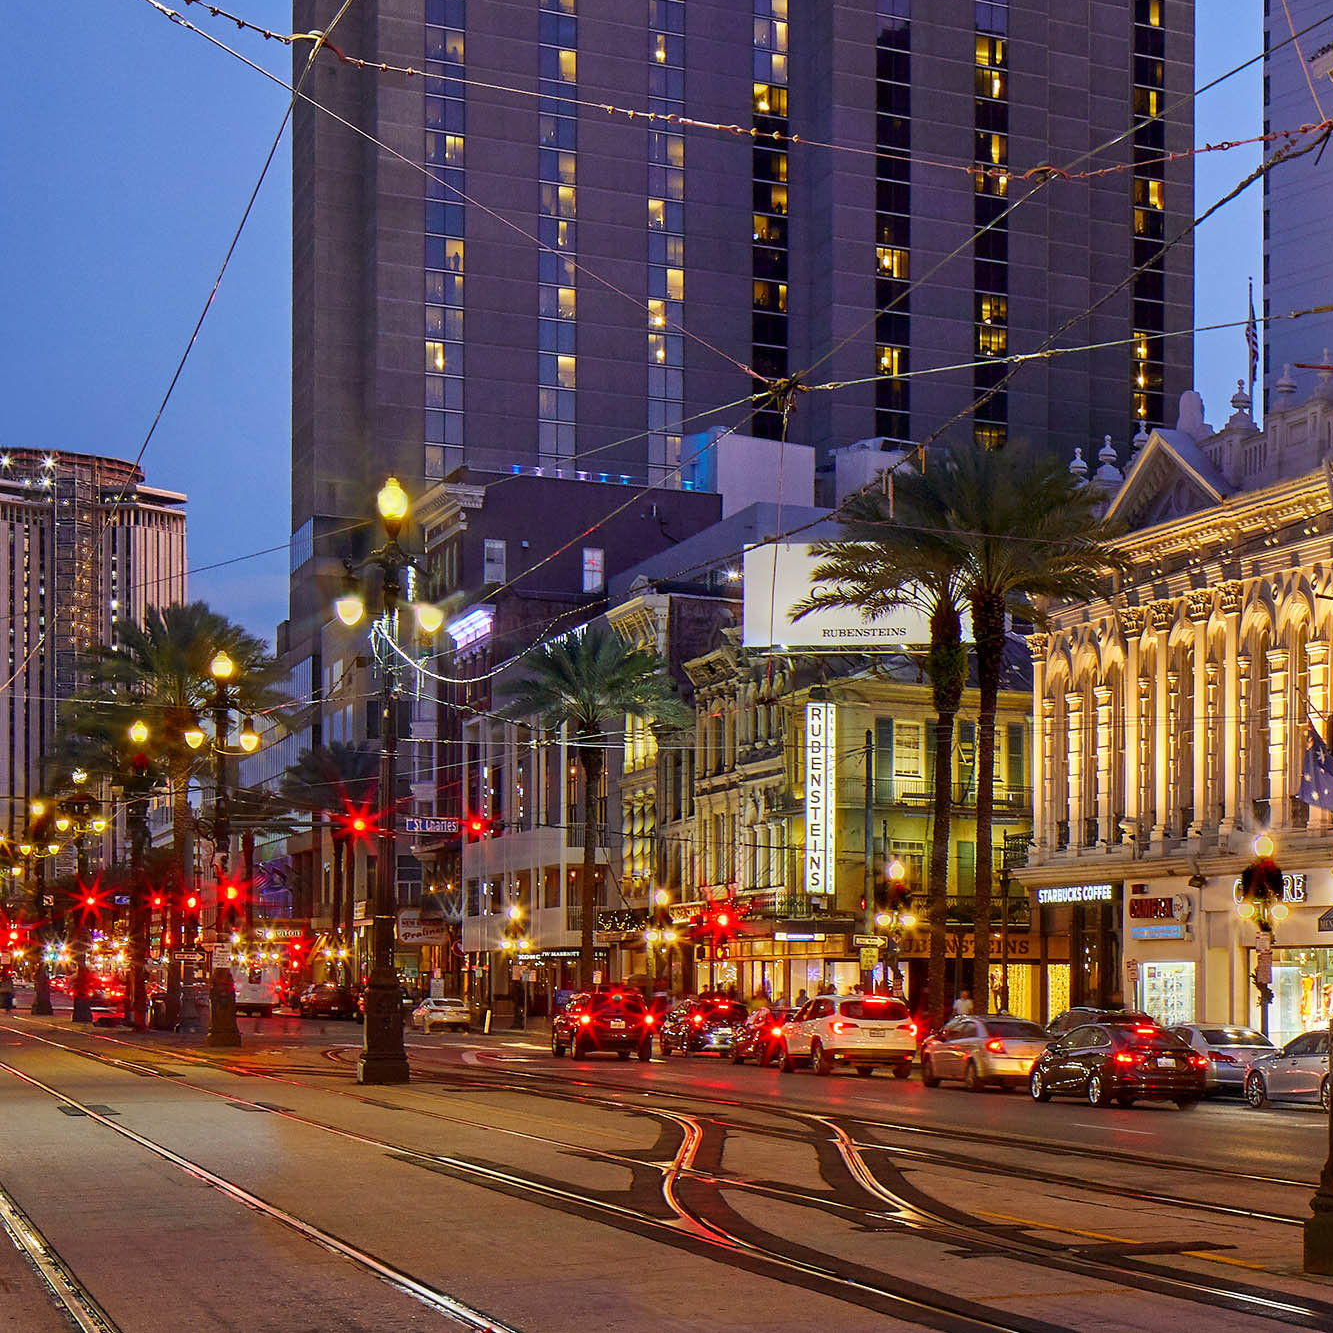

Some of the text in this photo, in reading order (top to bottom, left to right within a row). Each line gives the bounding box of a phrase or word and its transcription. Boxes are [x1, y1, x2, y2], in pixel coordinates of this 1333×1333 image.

[822, 627, 907, 639] RUBENSTEINS
[810, 707, 822, 887] RUBENSTEINS
[1038, 885, 1112, 903] STARBUCKS COFFEE
